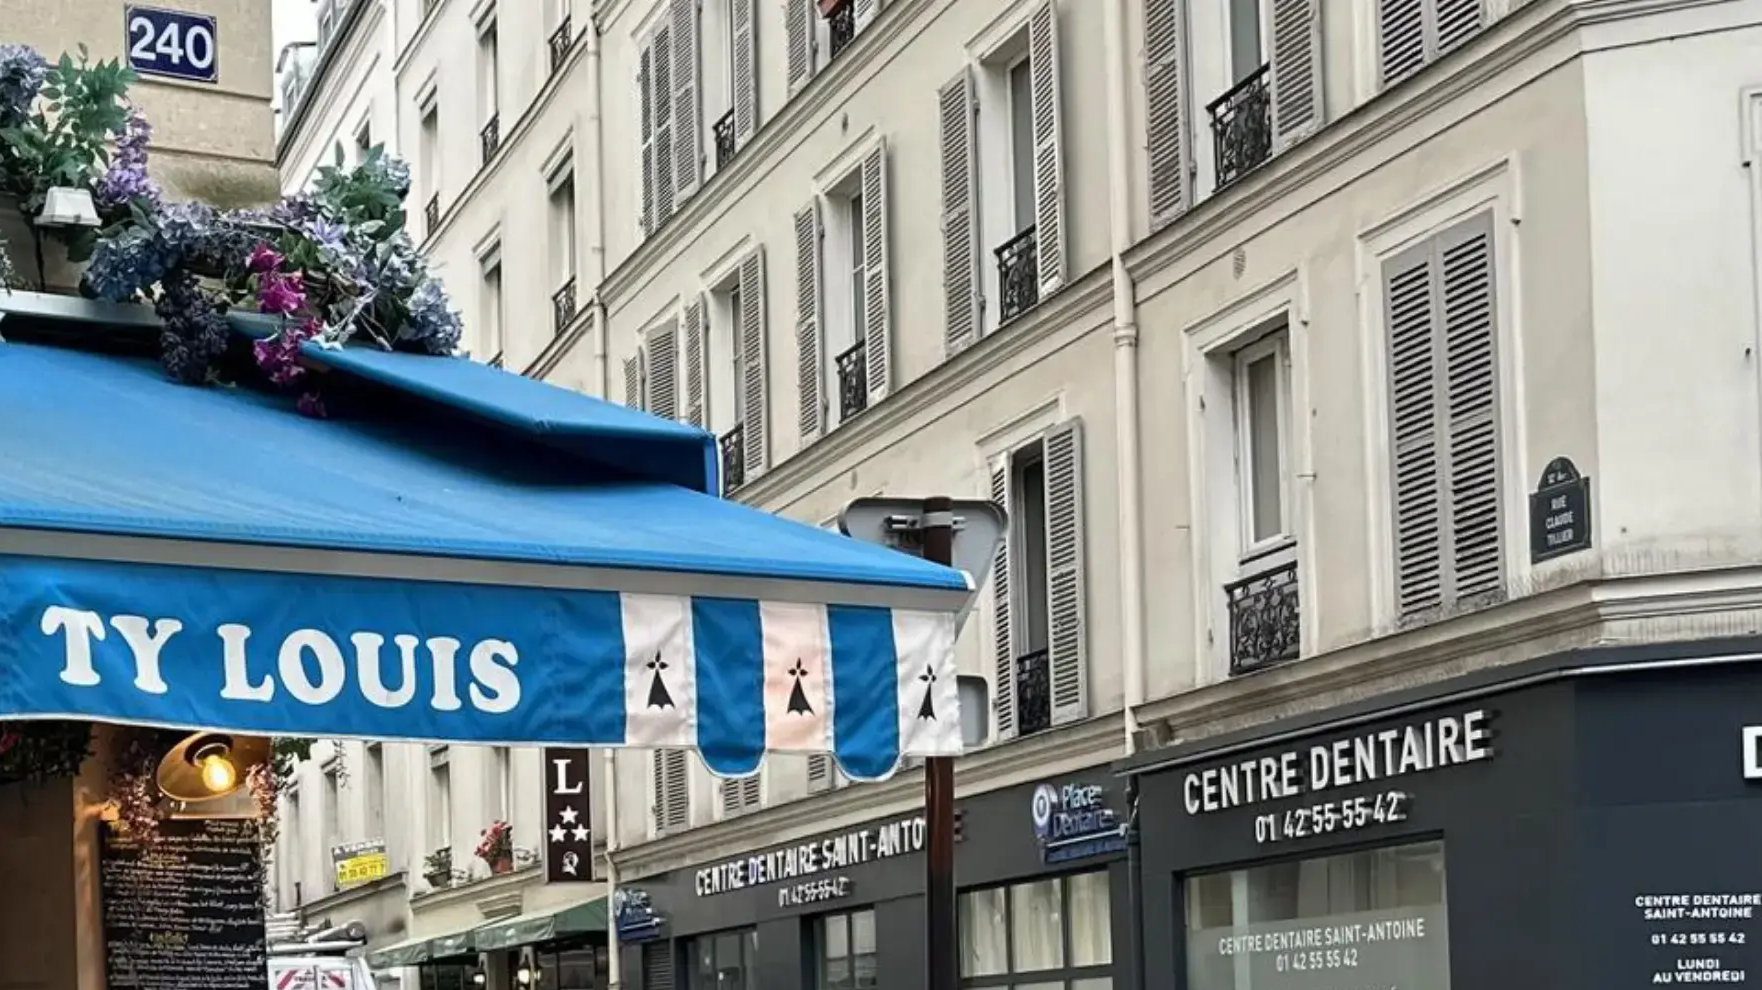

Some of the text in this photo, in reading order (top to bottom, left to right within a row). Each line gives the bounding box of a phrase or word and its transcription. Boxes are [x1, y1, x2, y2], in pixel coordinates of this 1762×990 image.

[129, 16, 214, 69] 240
[41, 605, 521, 715] TY LOUIS
[553, 759, 583, 794] L
[1184, 710, 1486, 814] CENTRE DENTAIRE
[1062, 783, 1101, 810] Place
[1255, 791, 1404, 843] 01 42 55 55 42
[695, 818, 926, 896] CENTRE DENTAIRE SAINT-ANTO
[1635, 894, 1762, 907] CENTRE DENTAIRE
[1644, 907, 1753, 920] SAINT-ANTOINE
[1219, 918, 1425, 954] CENTRE DENTAIRE SAINT-ANTOINE
[1651, 932, 1746, 945] 01 42 55 55 42
[1276, 948, 1358, 971] 01 42 55 55 42
[1677, 959, 1720, 970] LUNDI
[1652, 970, 1745, 984] AU VENDREDI
